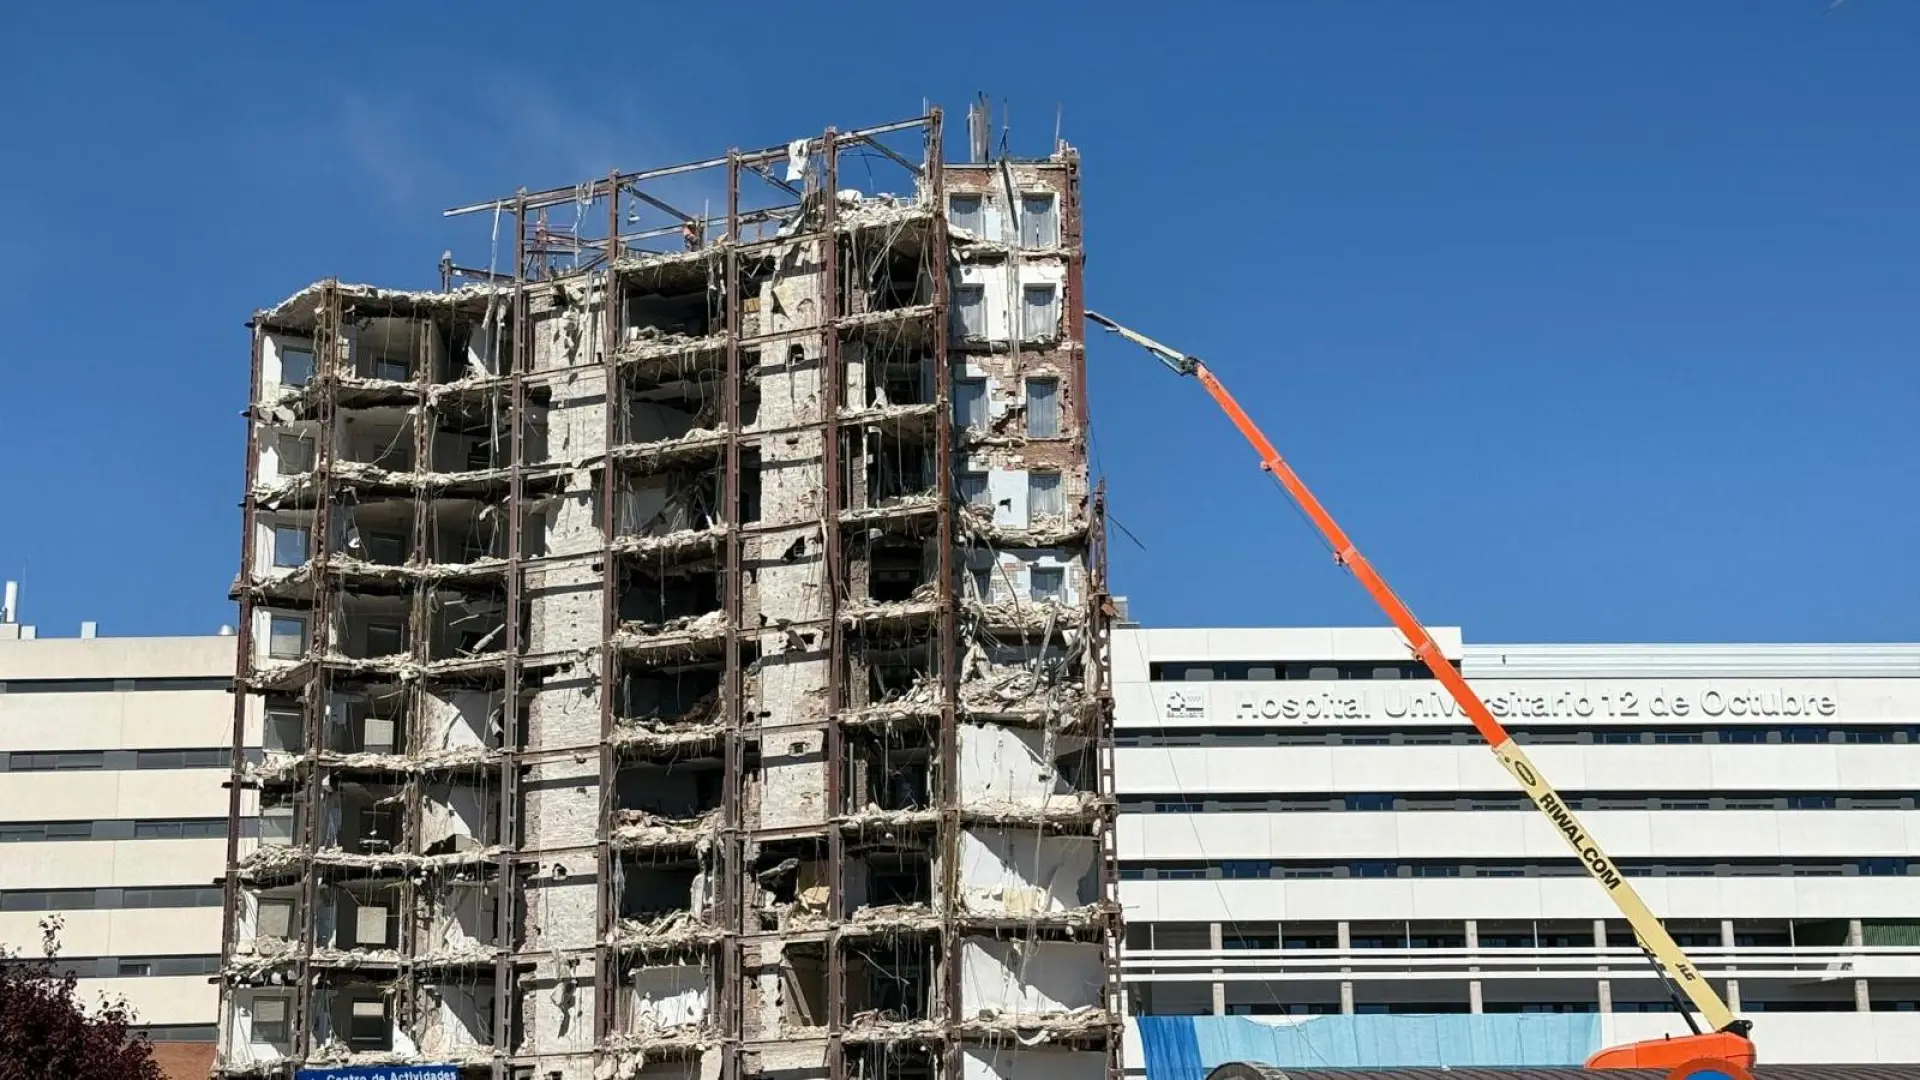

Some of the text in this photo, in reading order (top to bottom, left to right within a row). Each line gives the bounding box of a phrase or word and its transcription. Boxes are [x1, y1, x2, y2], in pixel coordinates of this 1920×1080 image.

[1235, 689, 1371, 724] Hospital
[1601, 690, 1640, 717] 12
[1649, 688, 1691, 717] de
[1700, 688, 1837, 717] Octubre
[1675, 963, 1696, 981] JLG
